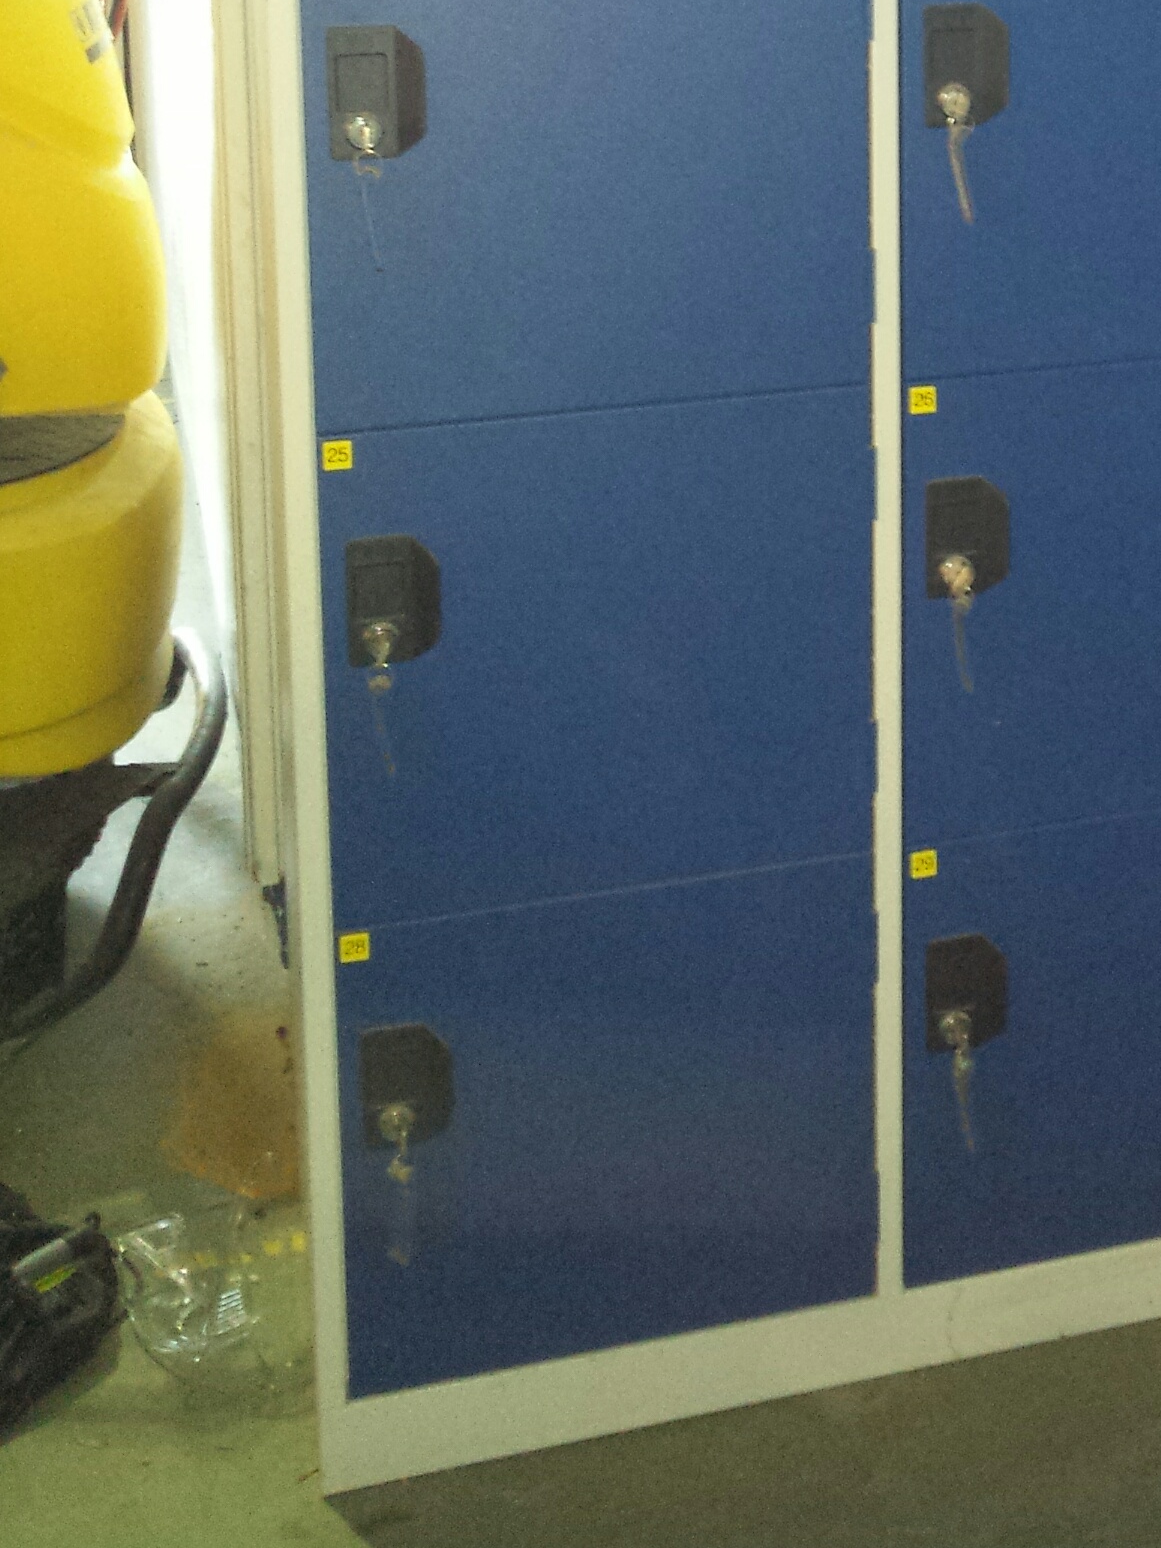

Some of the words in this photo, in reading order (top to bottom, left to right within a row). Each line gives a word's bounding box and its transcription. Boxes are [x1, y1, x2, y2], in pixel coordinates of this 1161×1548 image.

[913, 390, 935, 407] 26
[327, 446, 349, 463] 25
[344, 938, 366, 955] 28
